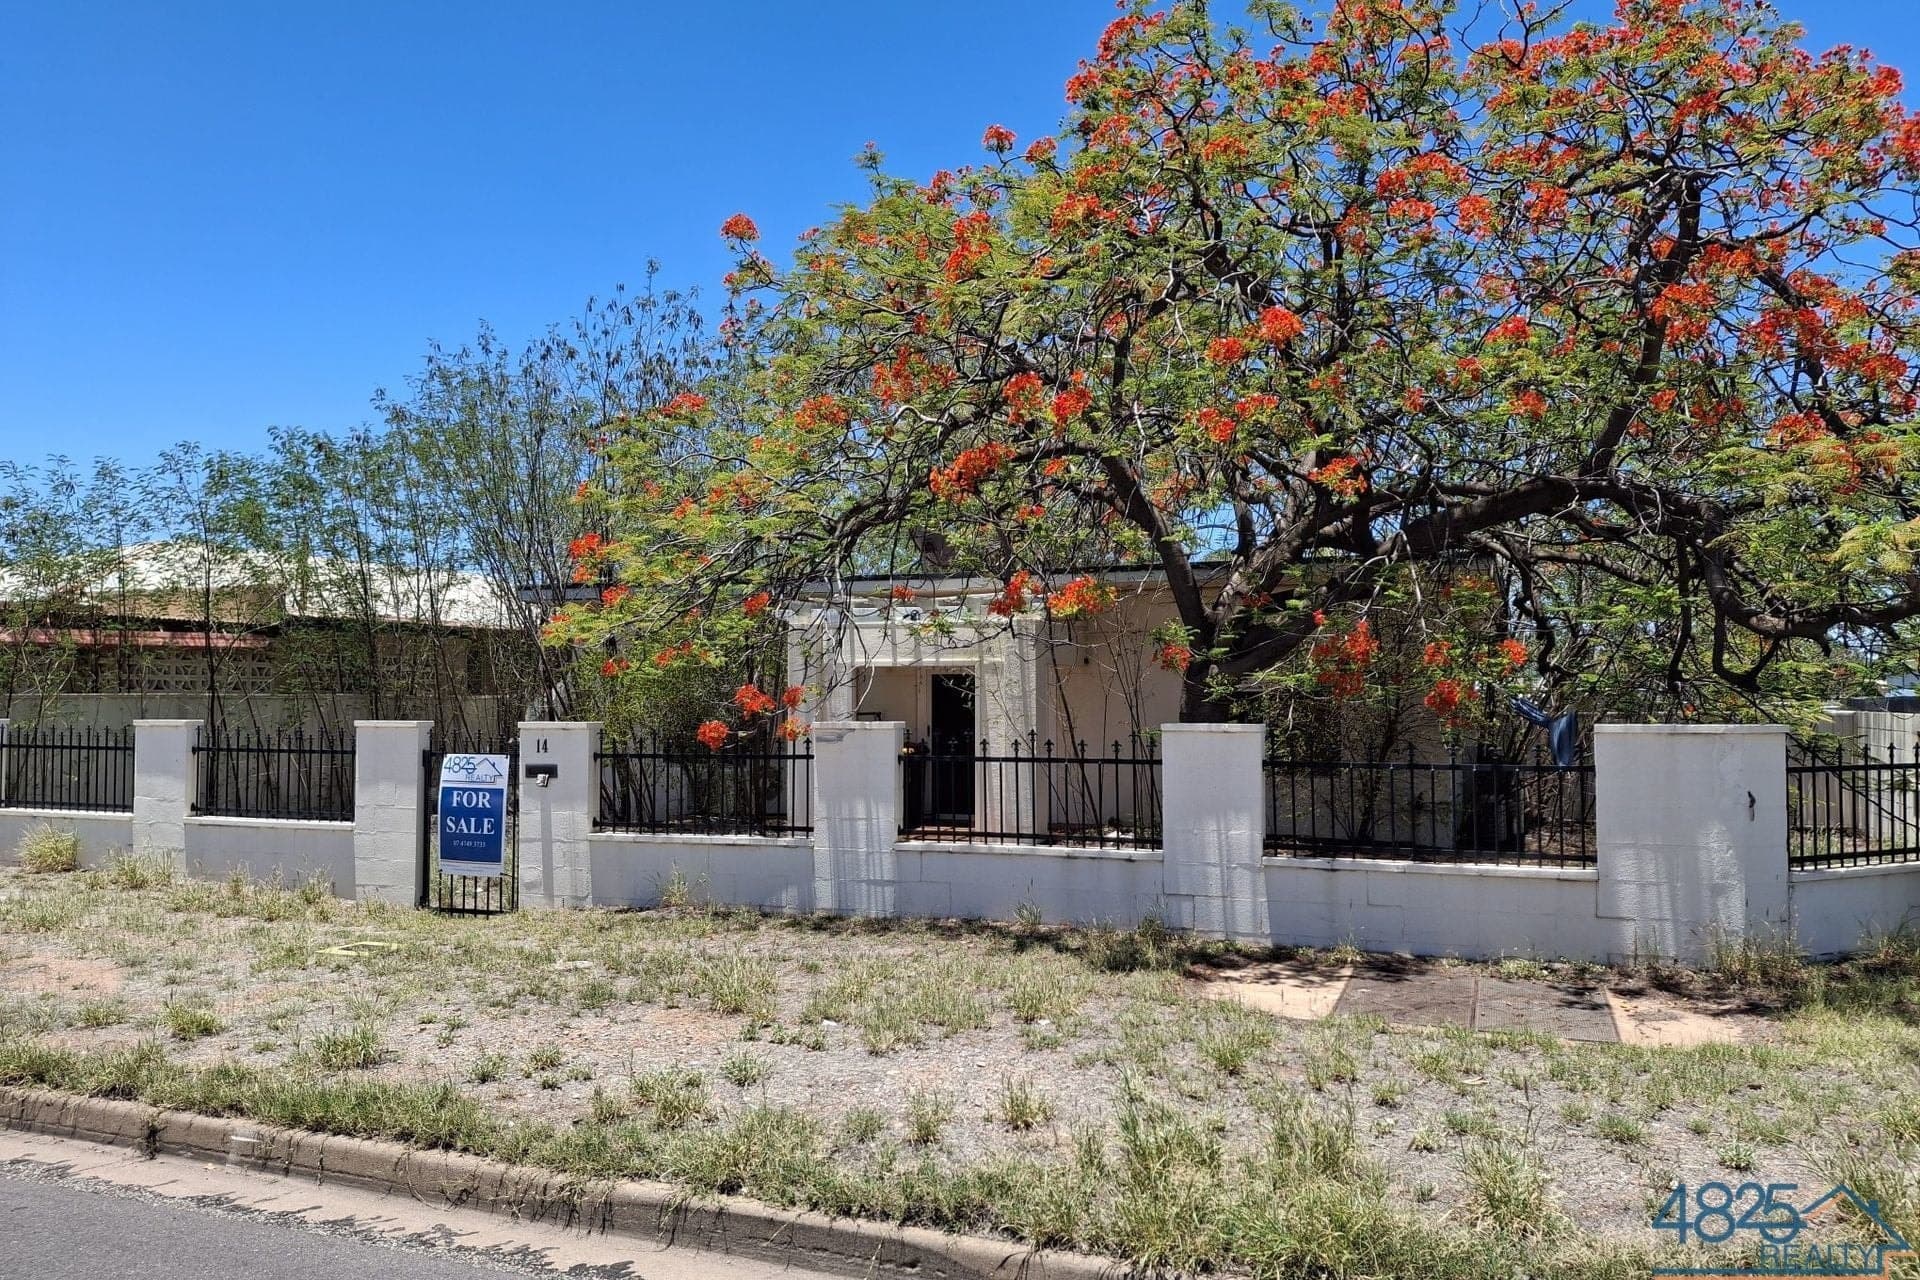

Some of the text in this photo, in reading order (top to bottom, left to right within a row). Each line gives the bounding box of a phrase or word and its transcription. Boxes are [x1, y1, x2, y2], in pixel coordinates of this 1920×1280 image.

[536, 738, 549, 753] 14
[444, 756, 477, 774] 4825
[465, 774, 494, 782] REALTY
[452, 790, 491, 808] FOR
[446, 816, 495, 834] SALE
